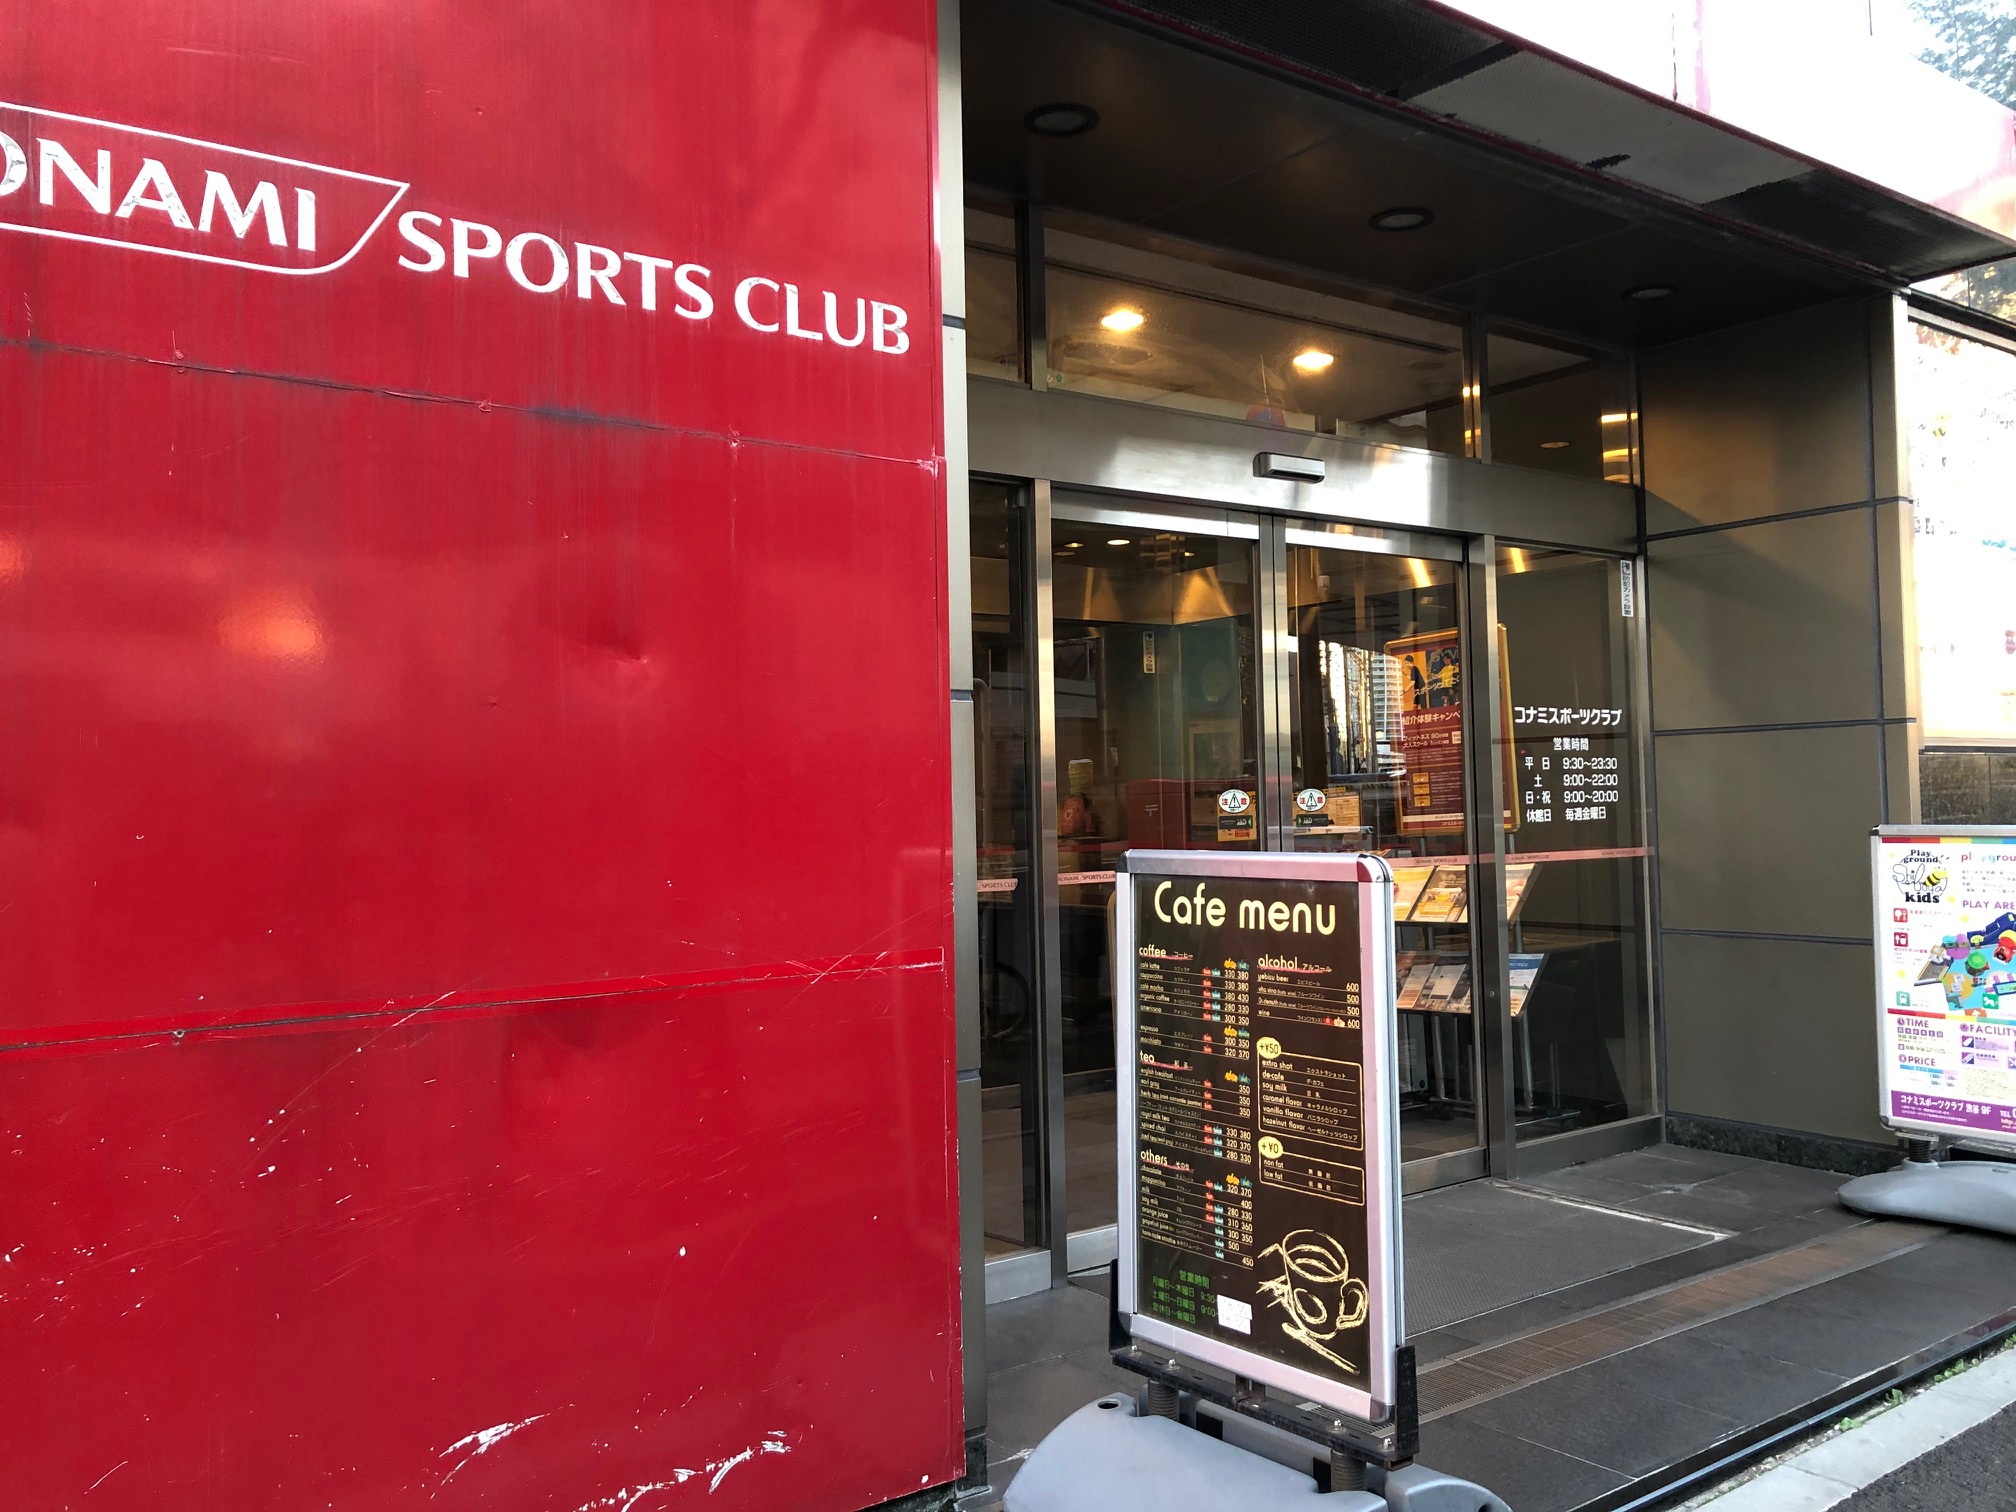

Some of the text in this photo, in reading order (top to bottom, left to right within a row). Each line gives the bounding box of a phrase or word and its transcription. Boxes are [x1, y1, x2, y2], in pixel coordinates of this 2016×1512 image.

[398, 209, 715, 321] SPORTS
[734, 277, 911, 355] CLUB
[1515, 706, 1622, 725] コナミスポーツクラブ
[1553, 737, 1589, 751] 営業時間
[1534, 774, 1542, 787] 土
[1527, 807, 1606, 822] 休館日 毎週金曜日
[1905, 892, 1940, 903] kids
[1154, 881, 1336, 935] Cafe menu
[1963, 900, 1989, 909] PLAY
[1139, 944, 1166, 957] coffee
[1258, 954, 1297, 970] alcohol
[1346, 982, 1359, 992] 600
[1238, 994, 1249, 1003] 430
[1346, 994, 1359, 1003] 500
[1347, 1007, 1359, 1015] 500
[1347, 1019, 1360, 1028] 600
[1906, 1018, 1929, 1028] TIME
[1140, 1050, 1154, 1062] tea
[1225, 1048, 1236, 1056] 320
[1239, 1050, 1249, 1058] 370
[1262, 1060, 1278, 1068] extra
[1279, 1061, 1293, 1070] shot
[1908, 1056, 1936, 1066] PRICE
[1239, 1085, 1250, 1094] 350
[1262, 1082, 1273, 1091] soy
[1239, 1096, 1250, 1105] 350
[1263, 1094, 1284, 1104] caramel
[1901, 1095, 1964, 1111] コナミスポーツクラブ
[1239, 1107, 1250, 1117] 350
[1263, 1106, 1283, 1116] vanilla
[1284, 1108, 1303, 1120] flavor
[1263, 1116, 1287, 1128] hazelnut
[1288, 1120, 1305, 1131] flavor
[1226, 1139, 1237, 1147] 320
[1240, 1141, 1251, 1151] 370
[1140, 1149, 1168, 1165] others
[1227, 1184, 1238, 1194] 320
[1240, 1187, 1252, 1197] 370
[1241, 1200, 1252, 1209] 400
[1227, 1219, 1239, 1228] 310
[1228, 1241, 1239, 1251] 500
[1242, 1257, 1253, 1267] 450
